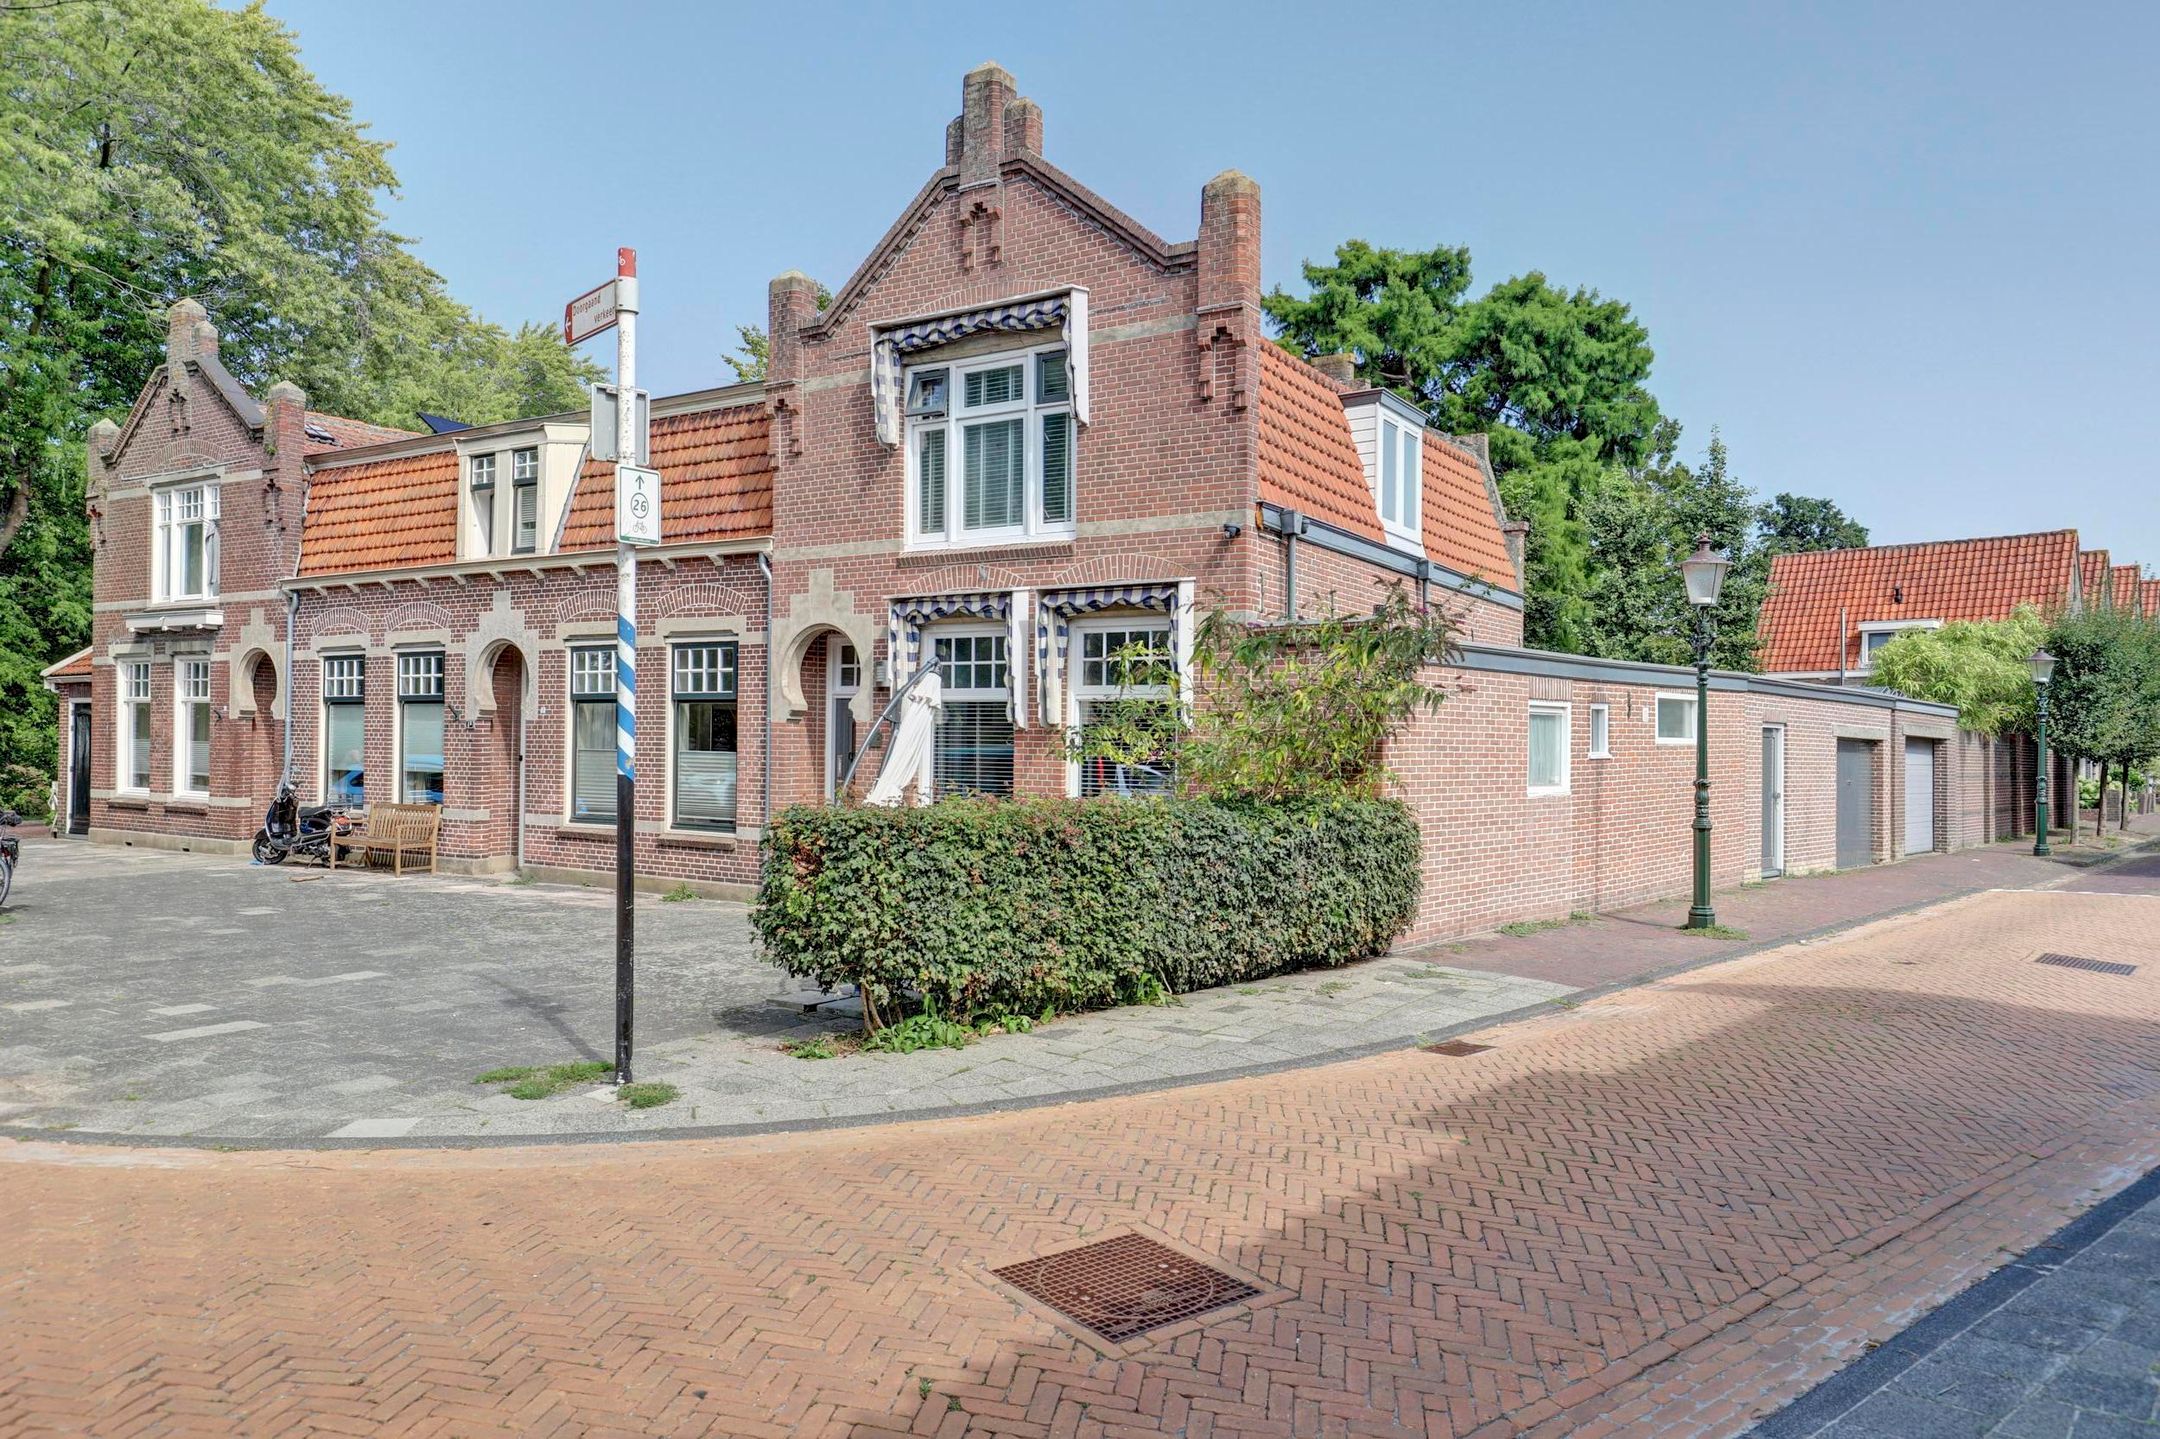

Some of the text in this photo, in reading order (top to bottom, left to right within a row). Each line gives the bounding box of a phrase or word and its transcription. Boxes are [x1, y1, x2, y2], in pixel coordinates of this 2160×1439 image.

[573, 292, 601, 317] Doorgaand
[593, 306, 616, 324] verkeer
[633, 499, 647, 512] 26
